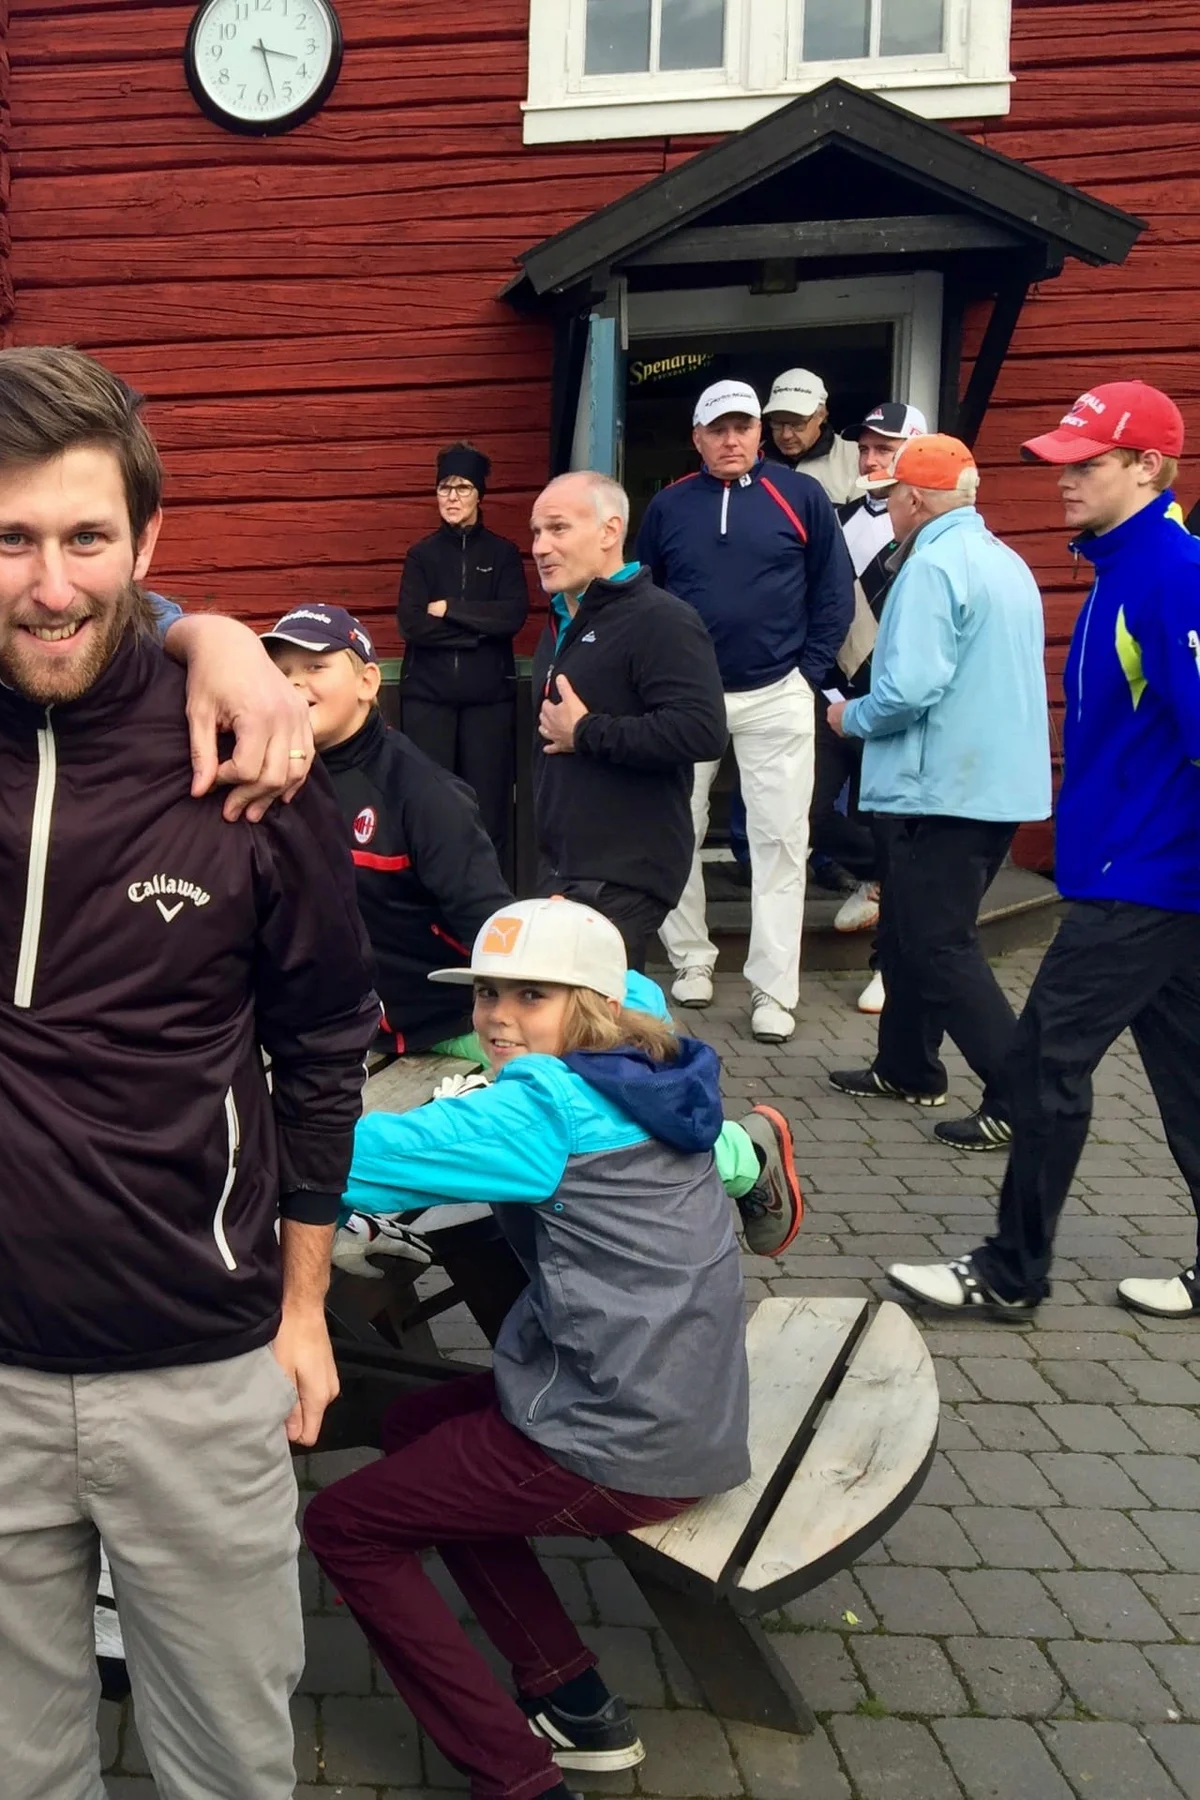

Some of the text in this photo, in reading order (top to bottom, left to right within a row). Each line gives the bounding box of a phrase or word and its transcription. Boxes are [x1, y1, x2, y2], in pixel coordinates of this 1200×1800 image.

[236, 3, 249, 21] 11
[295, 12, 307, 31] 2
[219, 23, 237, 41] 10
[211, 44, 223, 62] 9
[305, 37, 316, 56] 3
[218, 67, 230, 85] 8
[296, 62, 308, 79] 4
[237, 83, 247, 100] 7
[257, 89, 269, 107] 6
[281, 80, 293, 102] 5
[127, 873, 211, 907] Callaway
